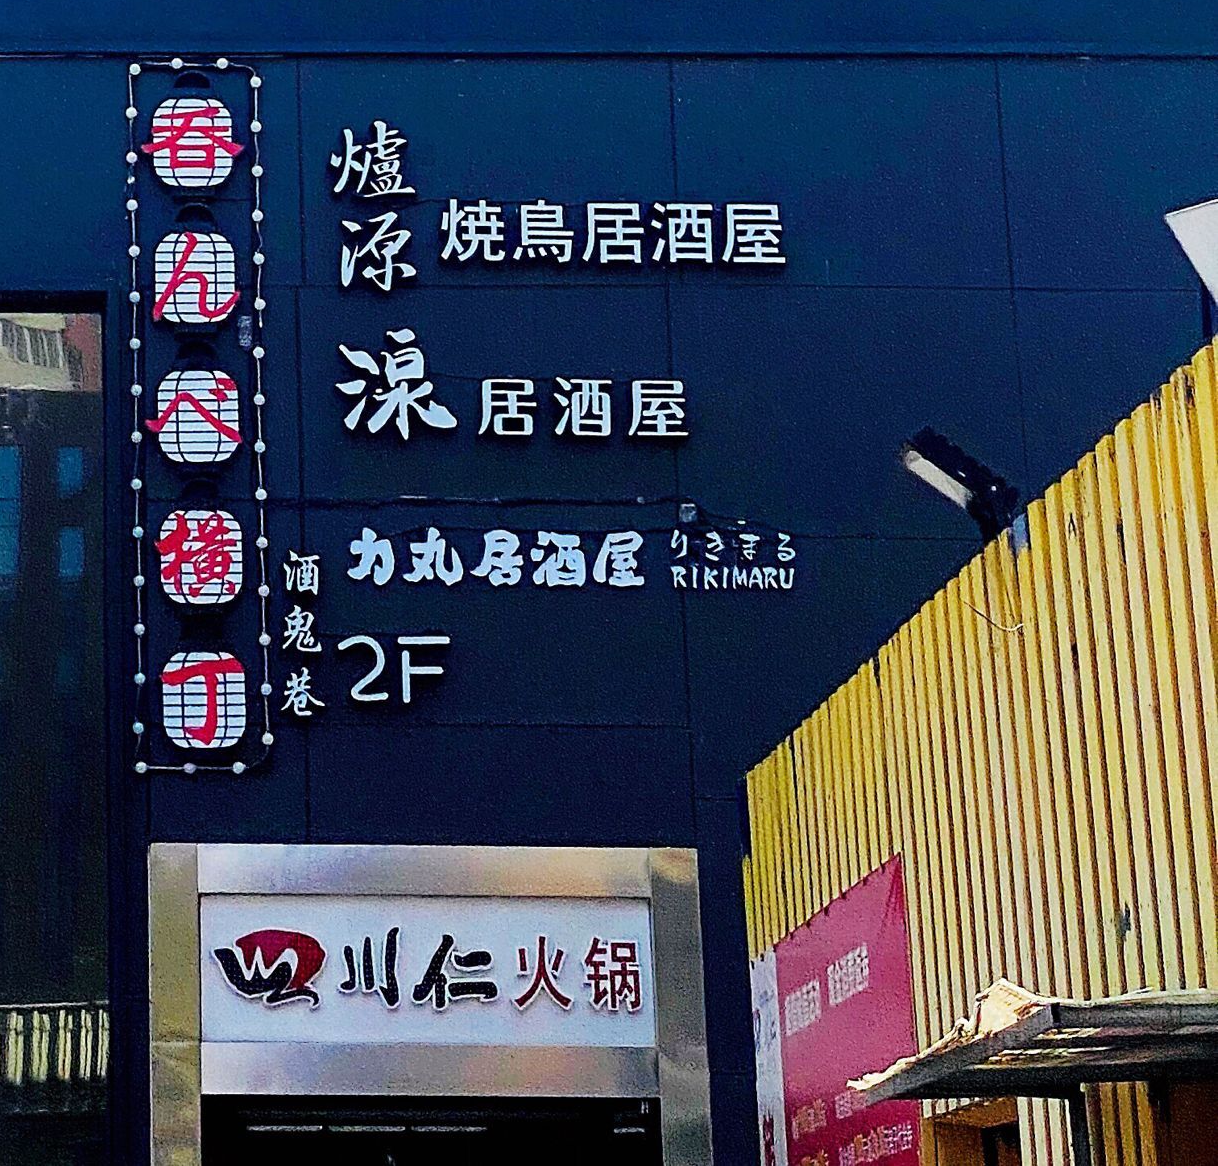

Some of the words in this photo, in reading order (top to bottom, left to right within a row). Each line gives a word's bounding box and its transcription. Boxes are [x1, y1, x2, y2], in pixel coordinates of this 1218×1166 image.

[439, 198, 788, 265] 焼鳥居酒屋
[346, 526, 646, 588] 力丸居酒屋
[670, 529, 797, 562] りきまる
[670, 565, 795, 590] RIKIMARU
[280, 549, 326, 717] 酒鬼巷
[337, 634, 451, 704] 2F
[336, 925, 644, 1012] 川仁火锅
